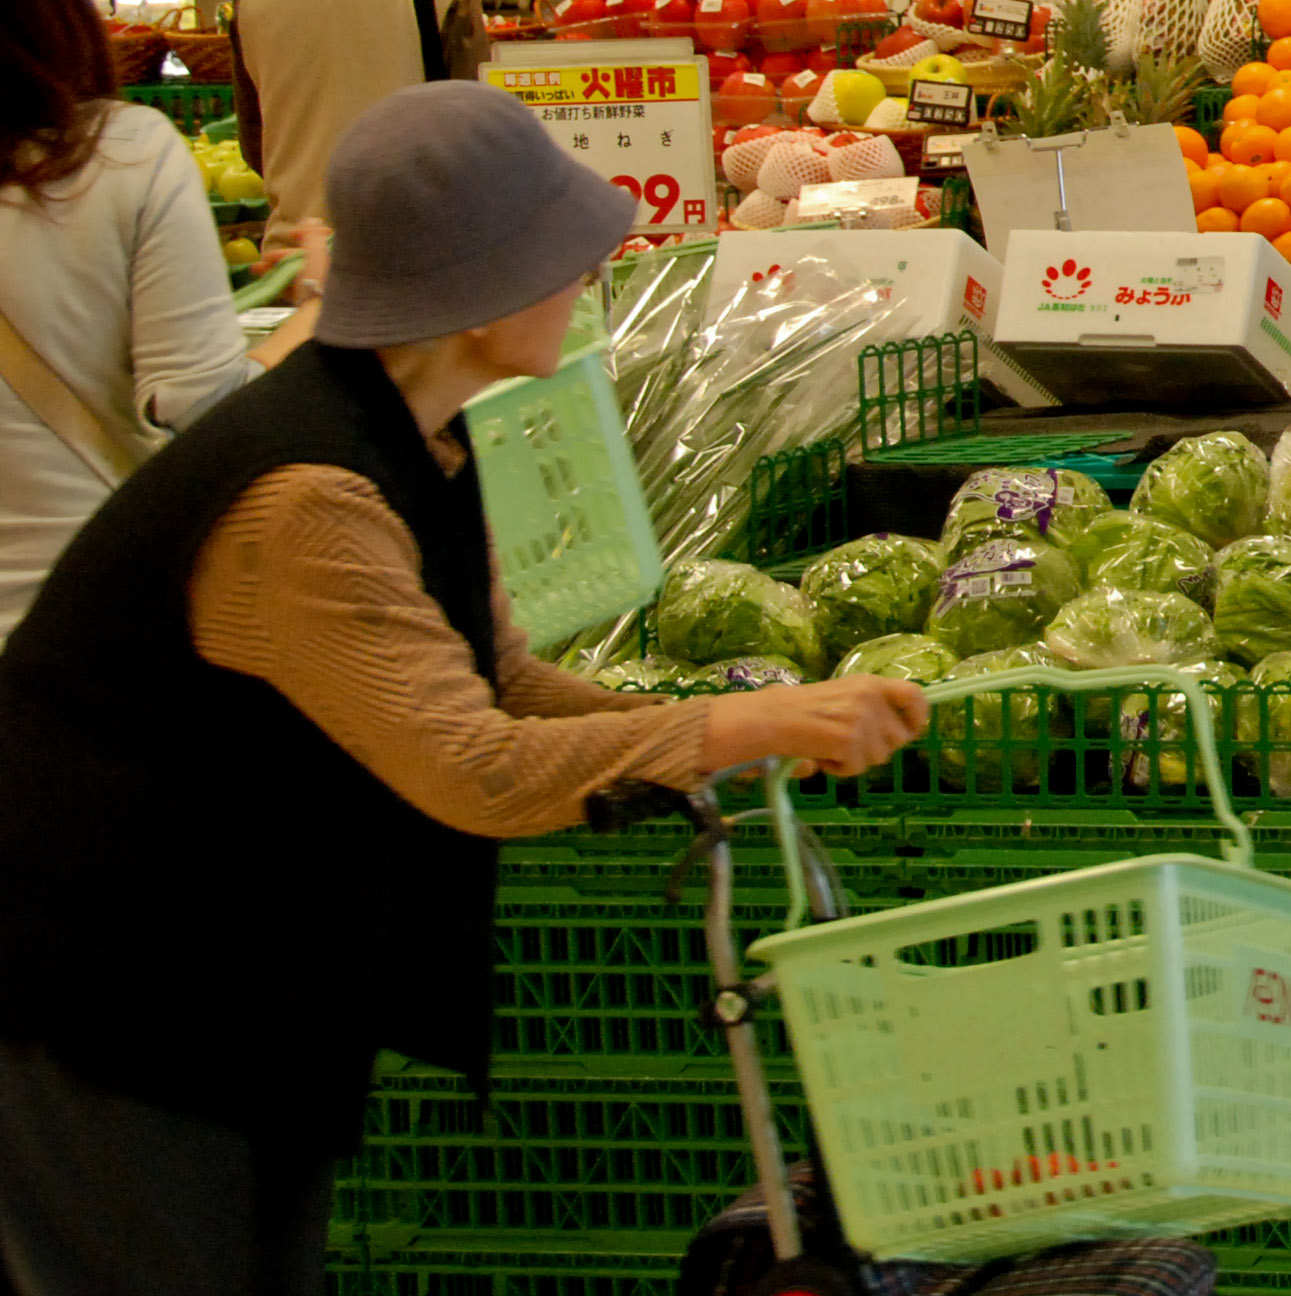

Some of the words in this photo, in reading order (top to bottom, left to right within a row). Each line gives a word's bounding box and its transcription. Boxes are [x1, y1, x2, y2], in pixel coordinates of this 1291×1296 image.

[581, 66, 677, 99] 火曜市
[512, 89, 575, 102] 買得いっぱい
[573, 130, 674, 150] 地ねぎ
